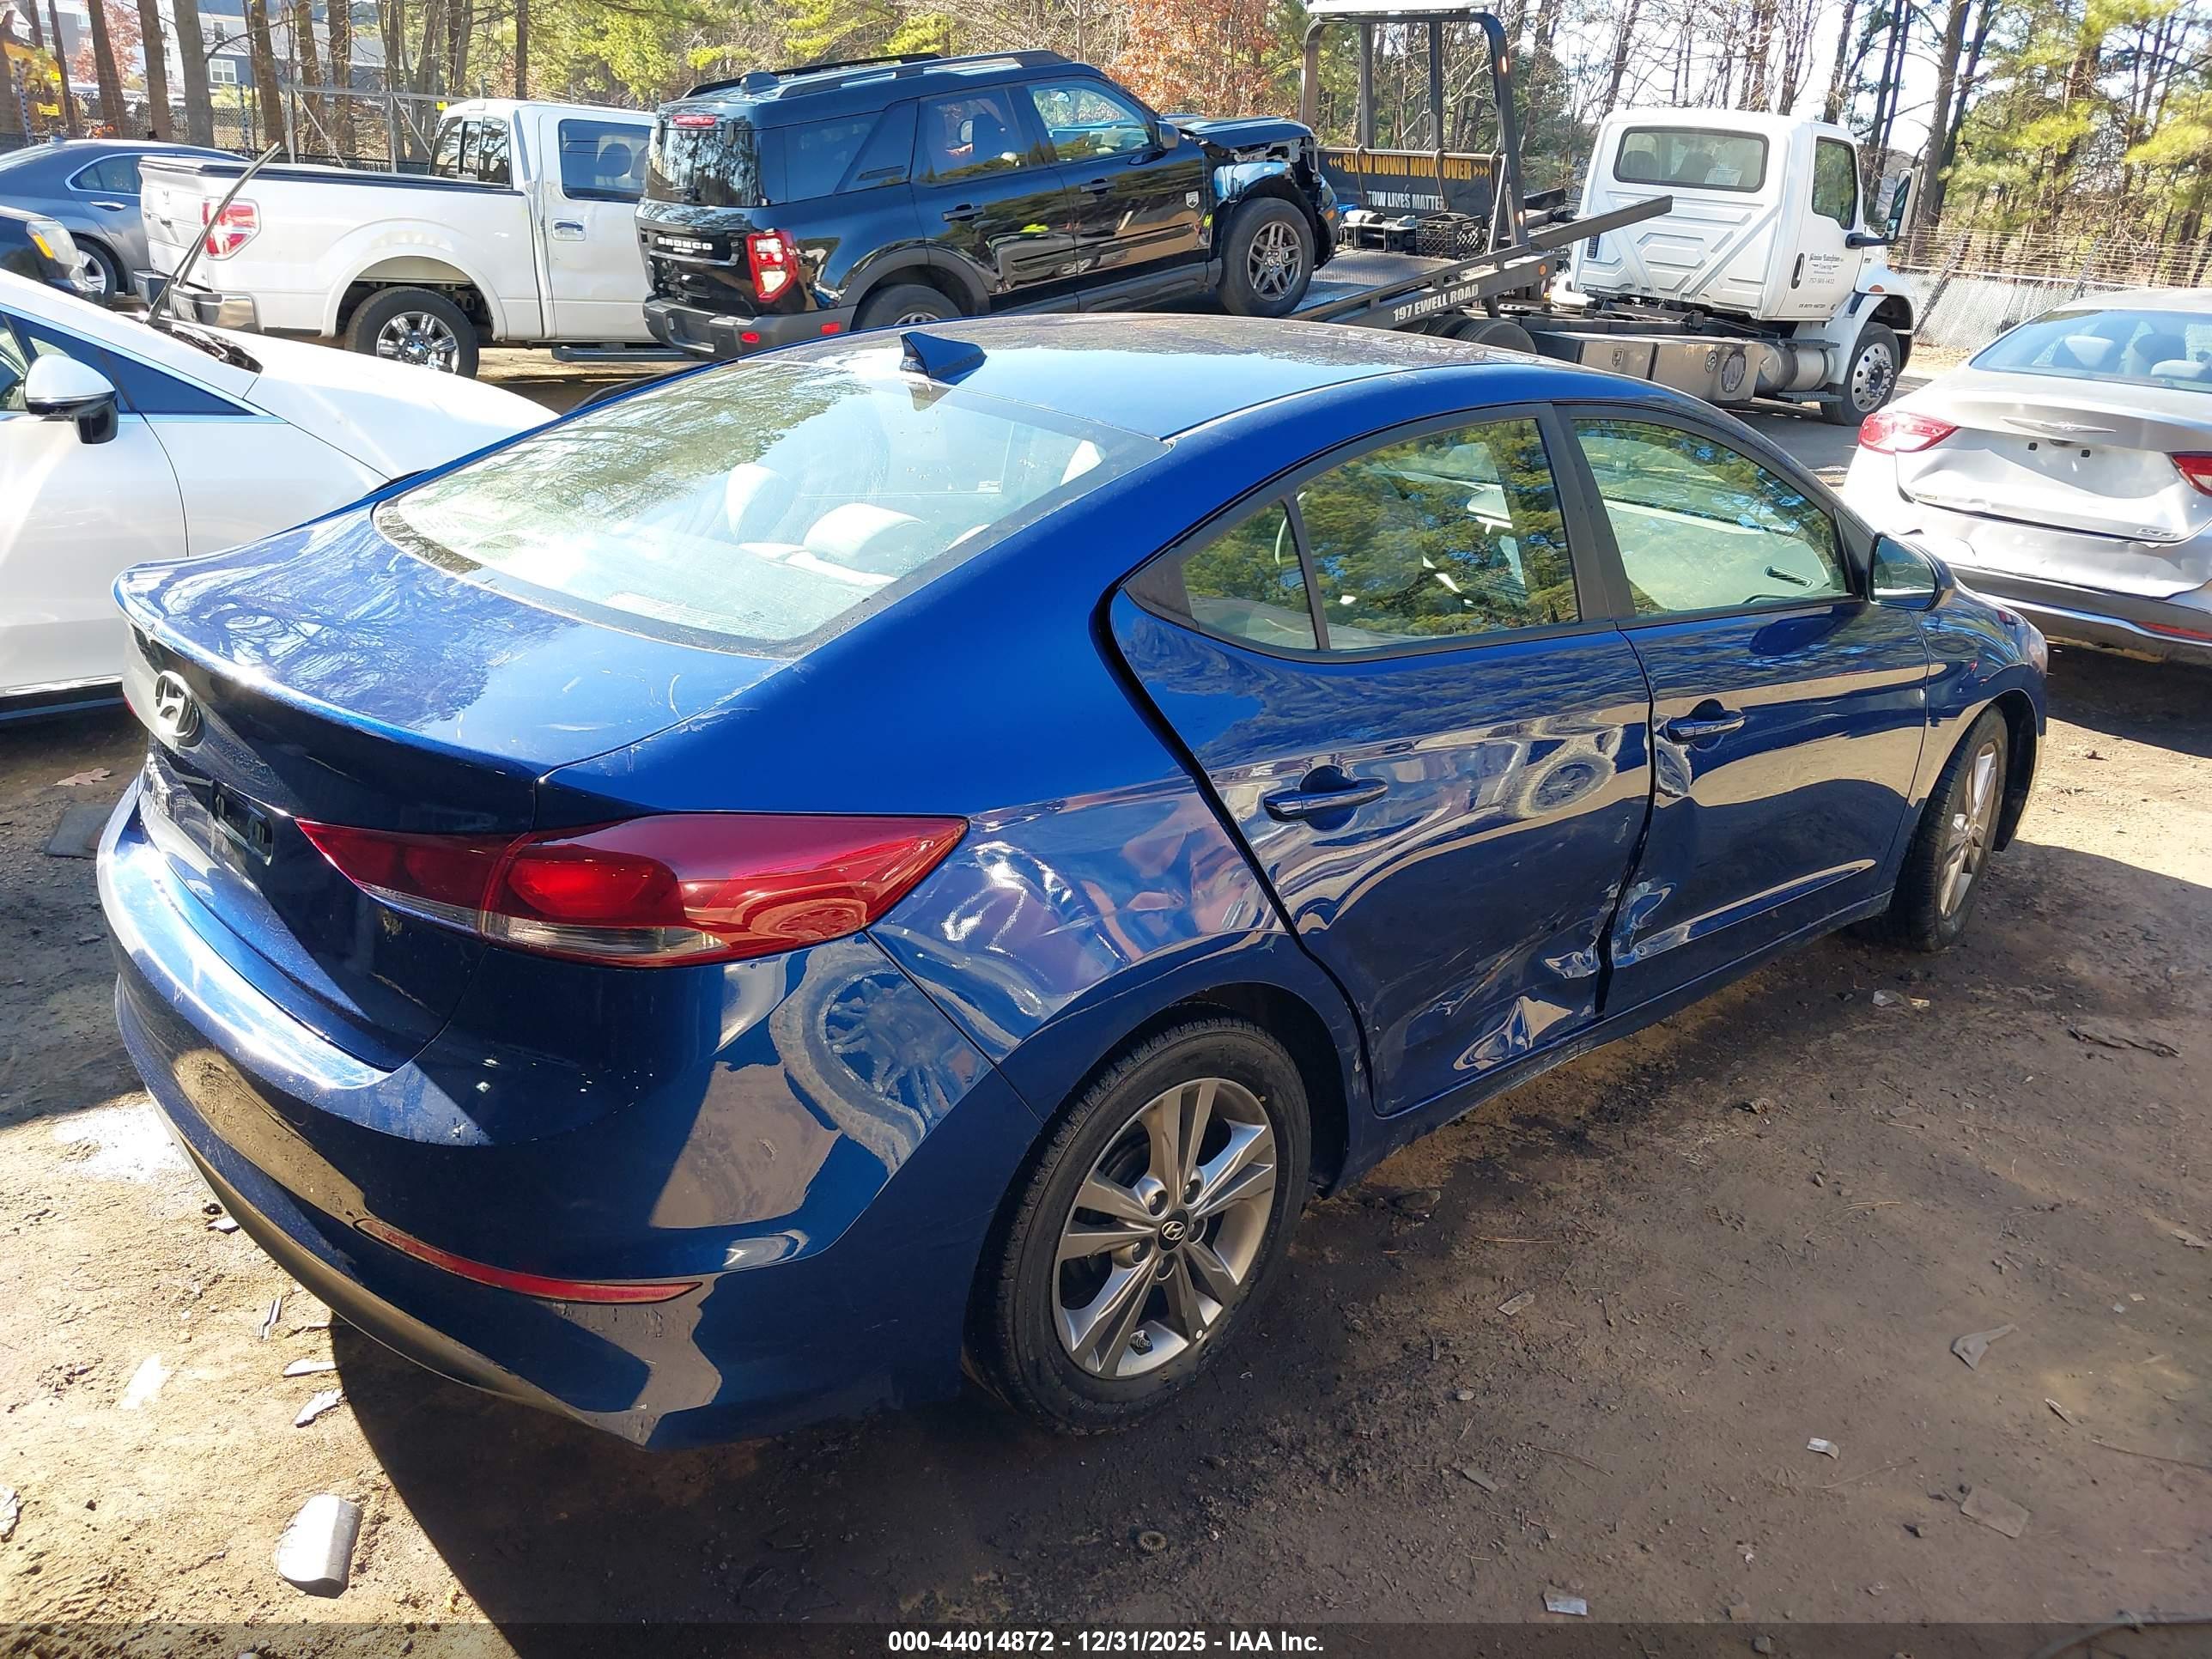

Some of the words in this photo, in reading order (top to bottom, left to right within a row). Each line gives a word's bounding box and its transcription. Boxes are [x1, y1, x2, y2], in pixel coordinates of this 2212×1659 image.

[1375, 155, 1407, 176] DOWN
[1410, 156, 1439, 178] MOV
[1443, 158, 1471, 180] OVER
[1366, 191, 1387, 207] TOW
[1388, 191, 1410, 209] LIVES
[657, 236, 714, 250] BRONCO
[1393, 304, 1413, 322] 197
[1414, 293, 1449, 315] EWELL
[1449, 283, 1479, 304] ROAD
